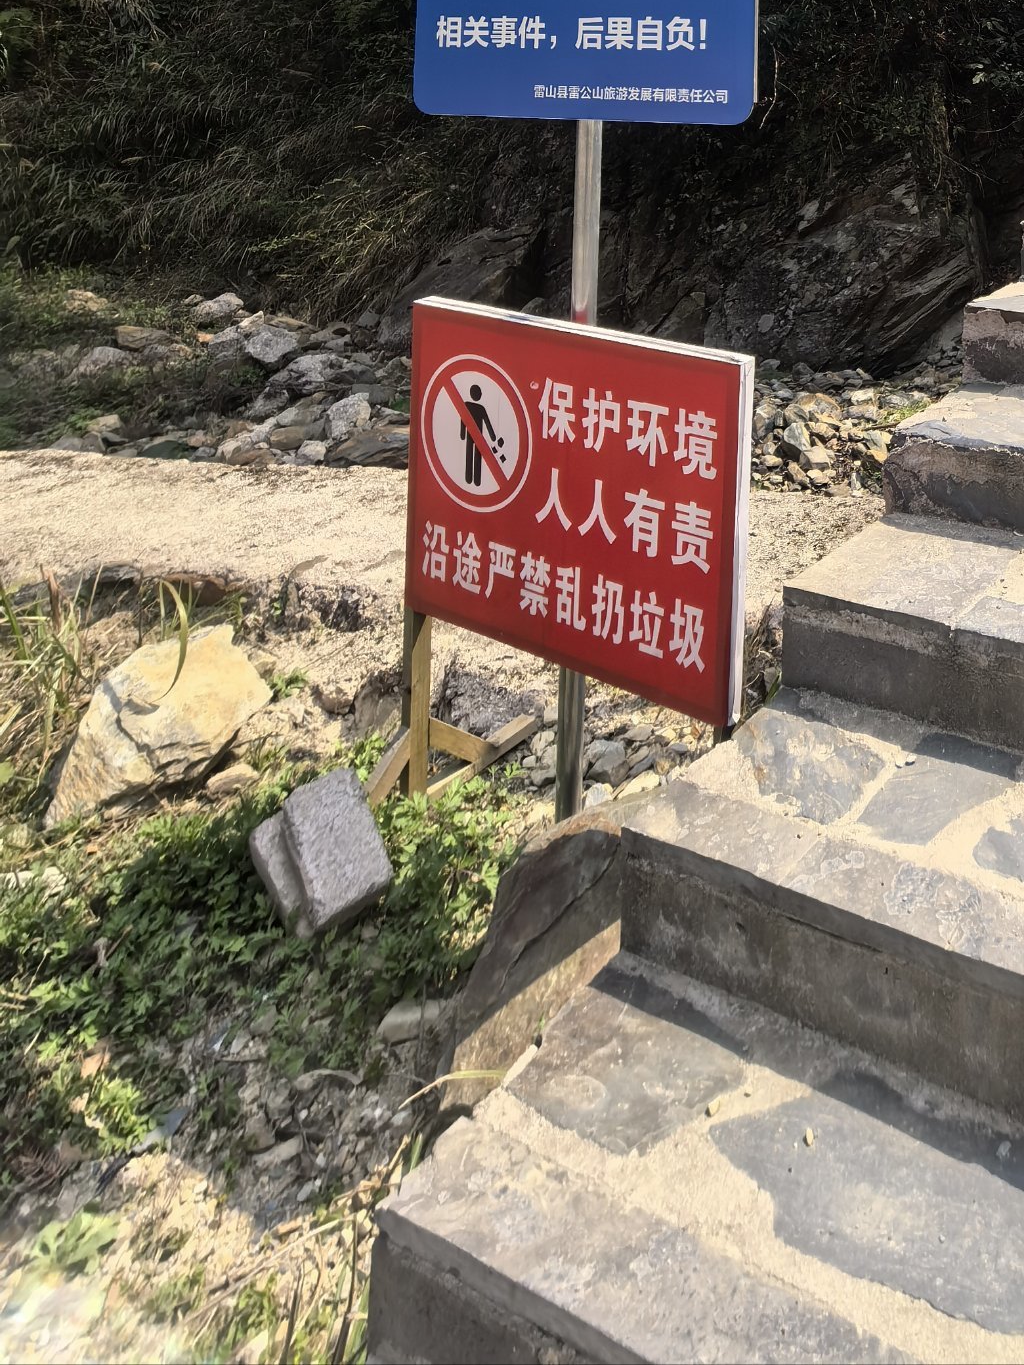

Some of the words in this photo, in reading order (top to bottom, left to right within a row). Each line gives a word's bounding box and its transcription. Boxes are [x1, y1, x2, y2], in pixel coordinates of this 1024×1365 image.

[436, 15, 707, 51] 相关事件，后果自负！
[533, 85, 728, 104] 雷山县雷公山旅游发展有限责任公司
[538, 377, 718, 480] 保护环境
[535, 468, 714, 574] 人人有责
[422, 520, 706, 673] 沿途严禁乱扔垃圾
